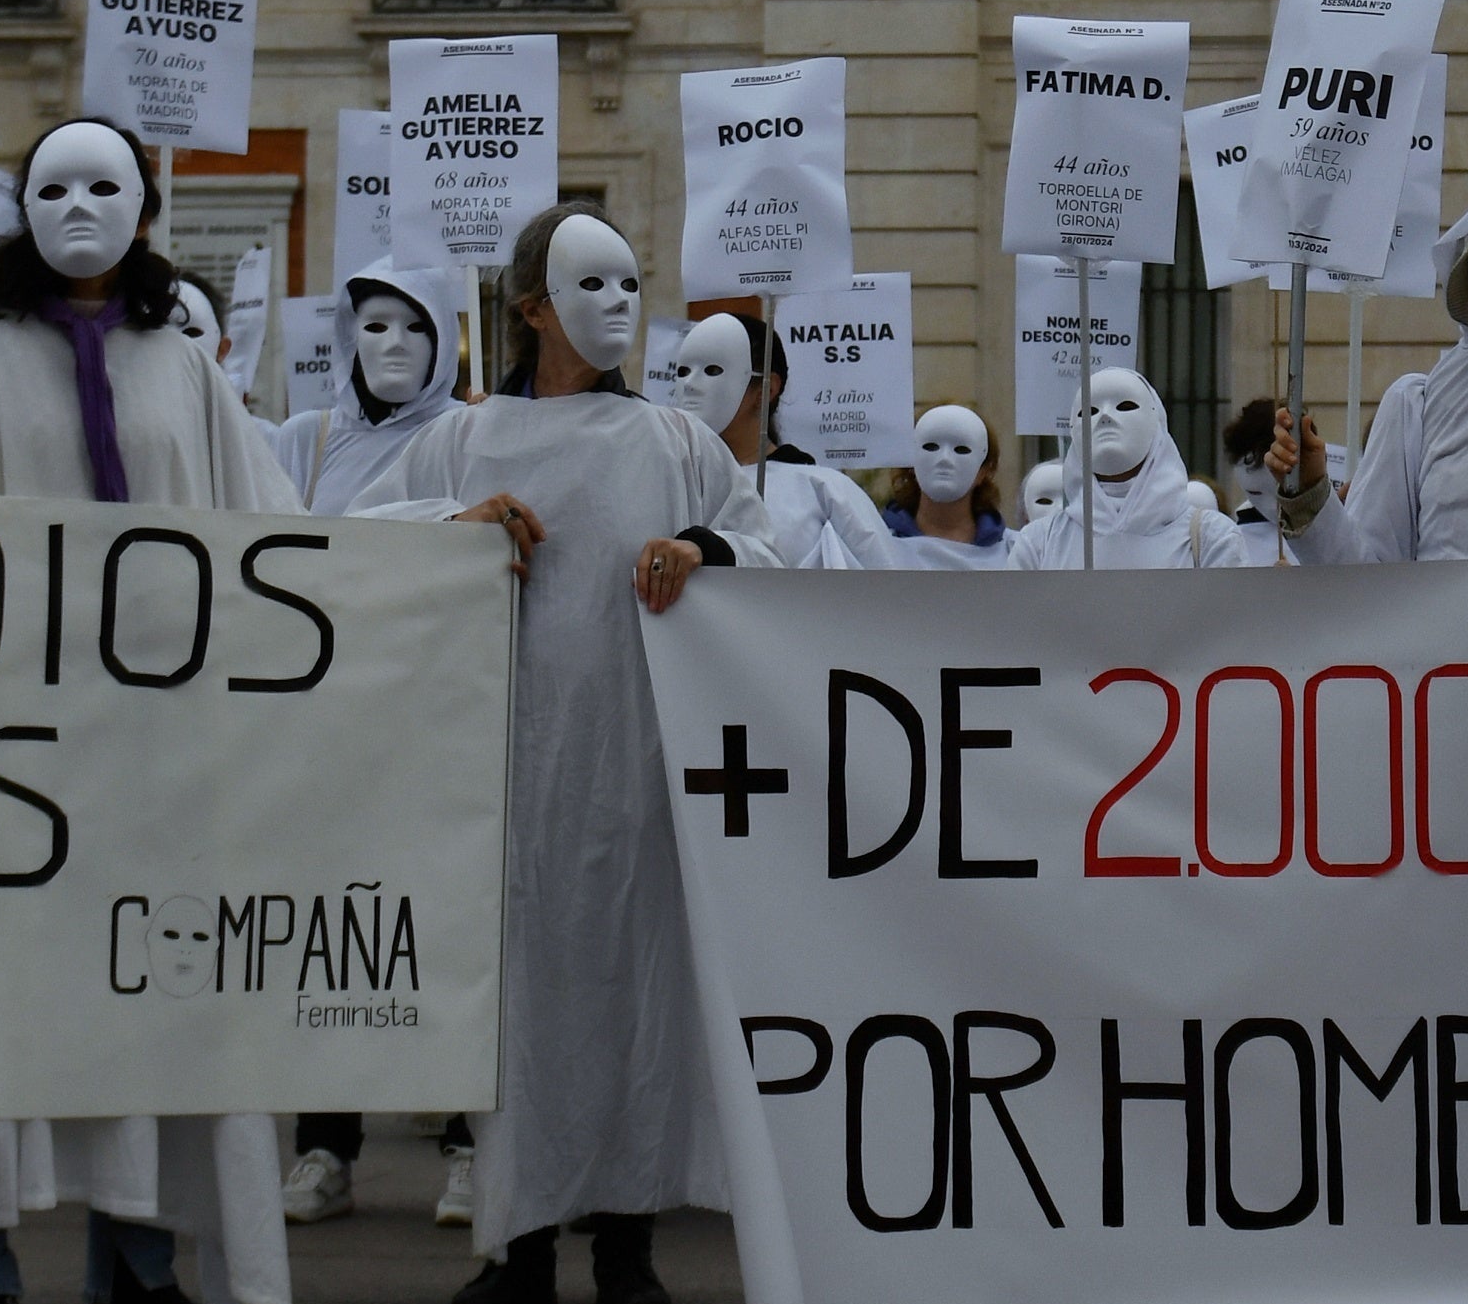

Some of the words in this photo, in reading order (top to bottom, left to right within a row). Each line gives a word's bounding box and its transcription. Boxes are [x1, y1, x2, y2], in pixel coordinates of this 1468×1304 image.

[124, 16, 218, 43] AYUSO
[1070, 26, 1122, 34] ASESINADA
[443, 45, 493, 54] ASESINADA
[134, 48, 158, 67] 70
[163, 52, 207, 72] años
[128, 75, 188, 90] MORATA
[191, 80, 208, 93] DE
[733, 74, 782, 84] ASESINADA
[1025, 69, 1136, 99] FATIMA
[1142, 77, 1171, 101] D.
[1278, 67, 1395, 120] PURI
[136, 103, 199, 122] (MADRID)
[422, 94, 522, 116] AMELIA
[401, 117, 544, 140] GUTIERREZ
[717, 116, 804, 147] ROCIO
[1289, 117, 1313, 138] 59
[1316, 121, 1370, 146] años
[425, 140, 519, 161] AYUSO
[1294, 141, 1342, 166] VÉLEZ
[1053, 154, 1078, 175] 44
[1083, 158, 1131, 178] años
[434, 171, 457, 189] 68
[464, 172, 509, 189] años
[1038, 182, 1120, 200] TORROELLA
[1124, 188, 1143, 201] DE
[431, 197, 490, 210] MORATA
[494, 197, 513, 208] DE
[725, 198, 748, 218] 44
[754, 197, 799, 216] años
[1055, 199, 1123, 214] MONTGRI
[443, 208, 500, 223] TAJUÑA
[1056, 213, 1121, 231] (GIRONA)
[441, 223, 503, 239] (MADRID)
[718, 225, 761, 240] ALFAS
[765, 223, 791, 237] DEL
[796, 223, 808, 235] PI
[724, 237, 803, 255] (ALICANTE)
[1061, 236, 1113, 247] 28/01/2024
[739, 274, 793, 285] 05/02/2024
[1046, 315, 1109, 331] NOMRE
[789, 323, 895, 344] NATALIA
[823, 345, 862, 364] S.S
[813, 390, 834, 406] 43
[837, 388, 874, 404] años
[821, 411, 867, 422] MADRID
[818, 422, 871, 435] (MADRID)
[827, 666, 1042, 880] DE
[296, 995, 420, 1029] Feminista
[740, 1009, 1066, 1233] POR
